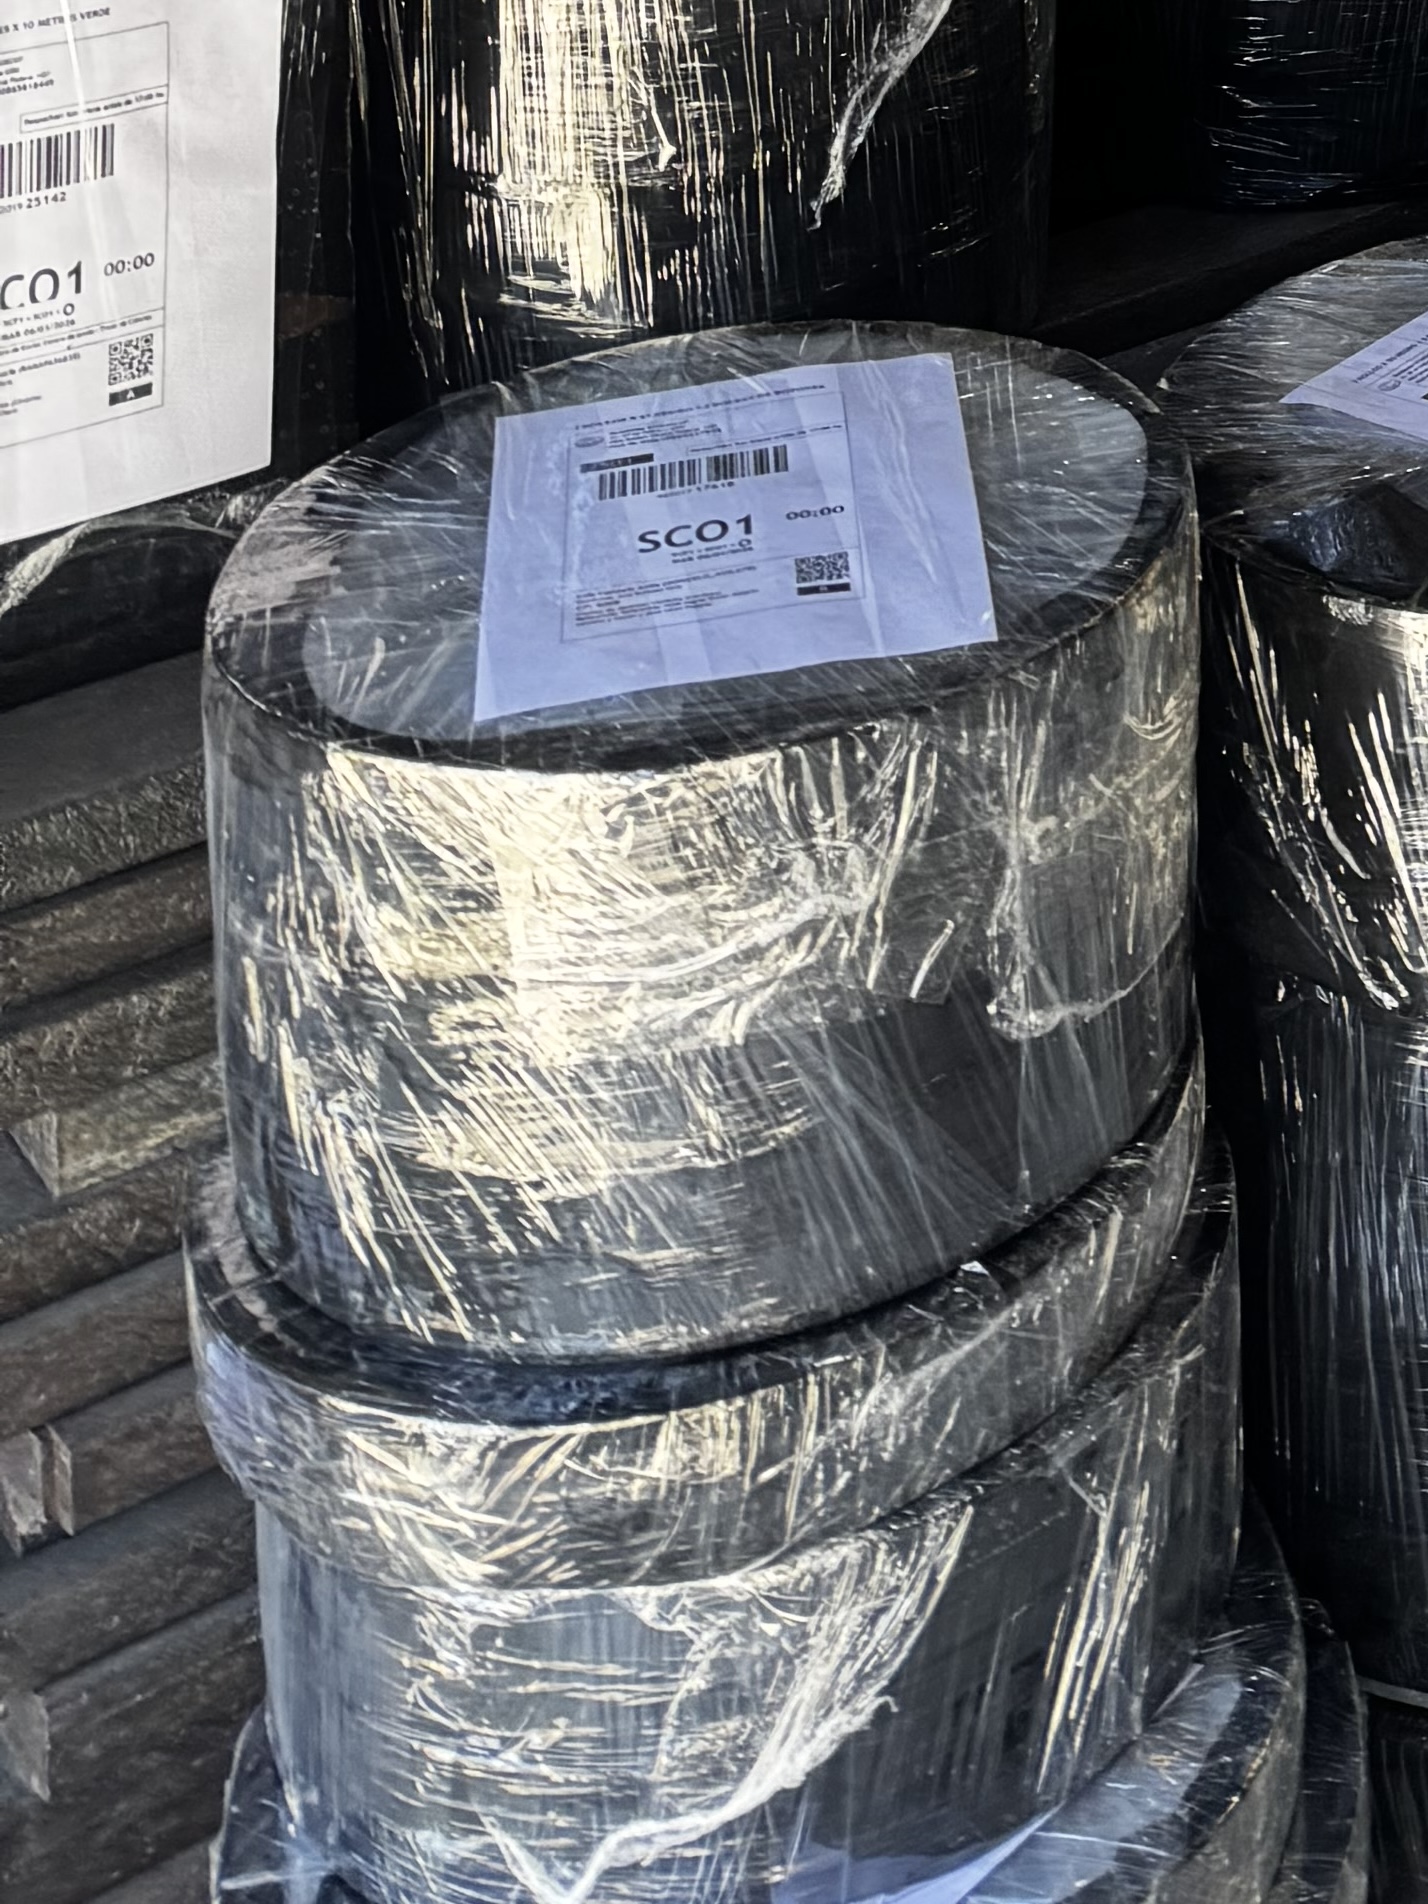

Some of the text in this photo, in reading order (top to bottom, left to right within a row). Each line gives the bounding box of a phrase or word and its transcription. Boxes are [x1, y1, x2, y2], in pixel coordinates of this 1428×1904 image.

[38, 13, 77, 27] METRS
[80, 7, 111, 21] VERDE
[26, 192, 67, 209] 25142
[103, 252, 155, 277] 00:00
[0, 260, 83, 310] CO1
[785, 504, 845, 521] 00:00
[637, 514, 753, 553] SCO1
